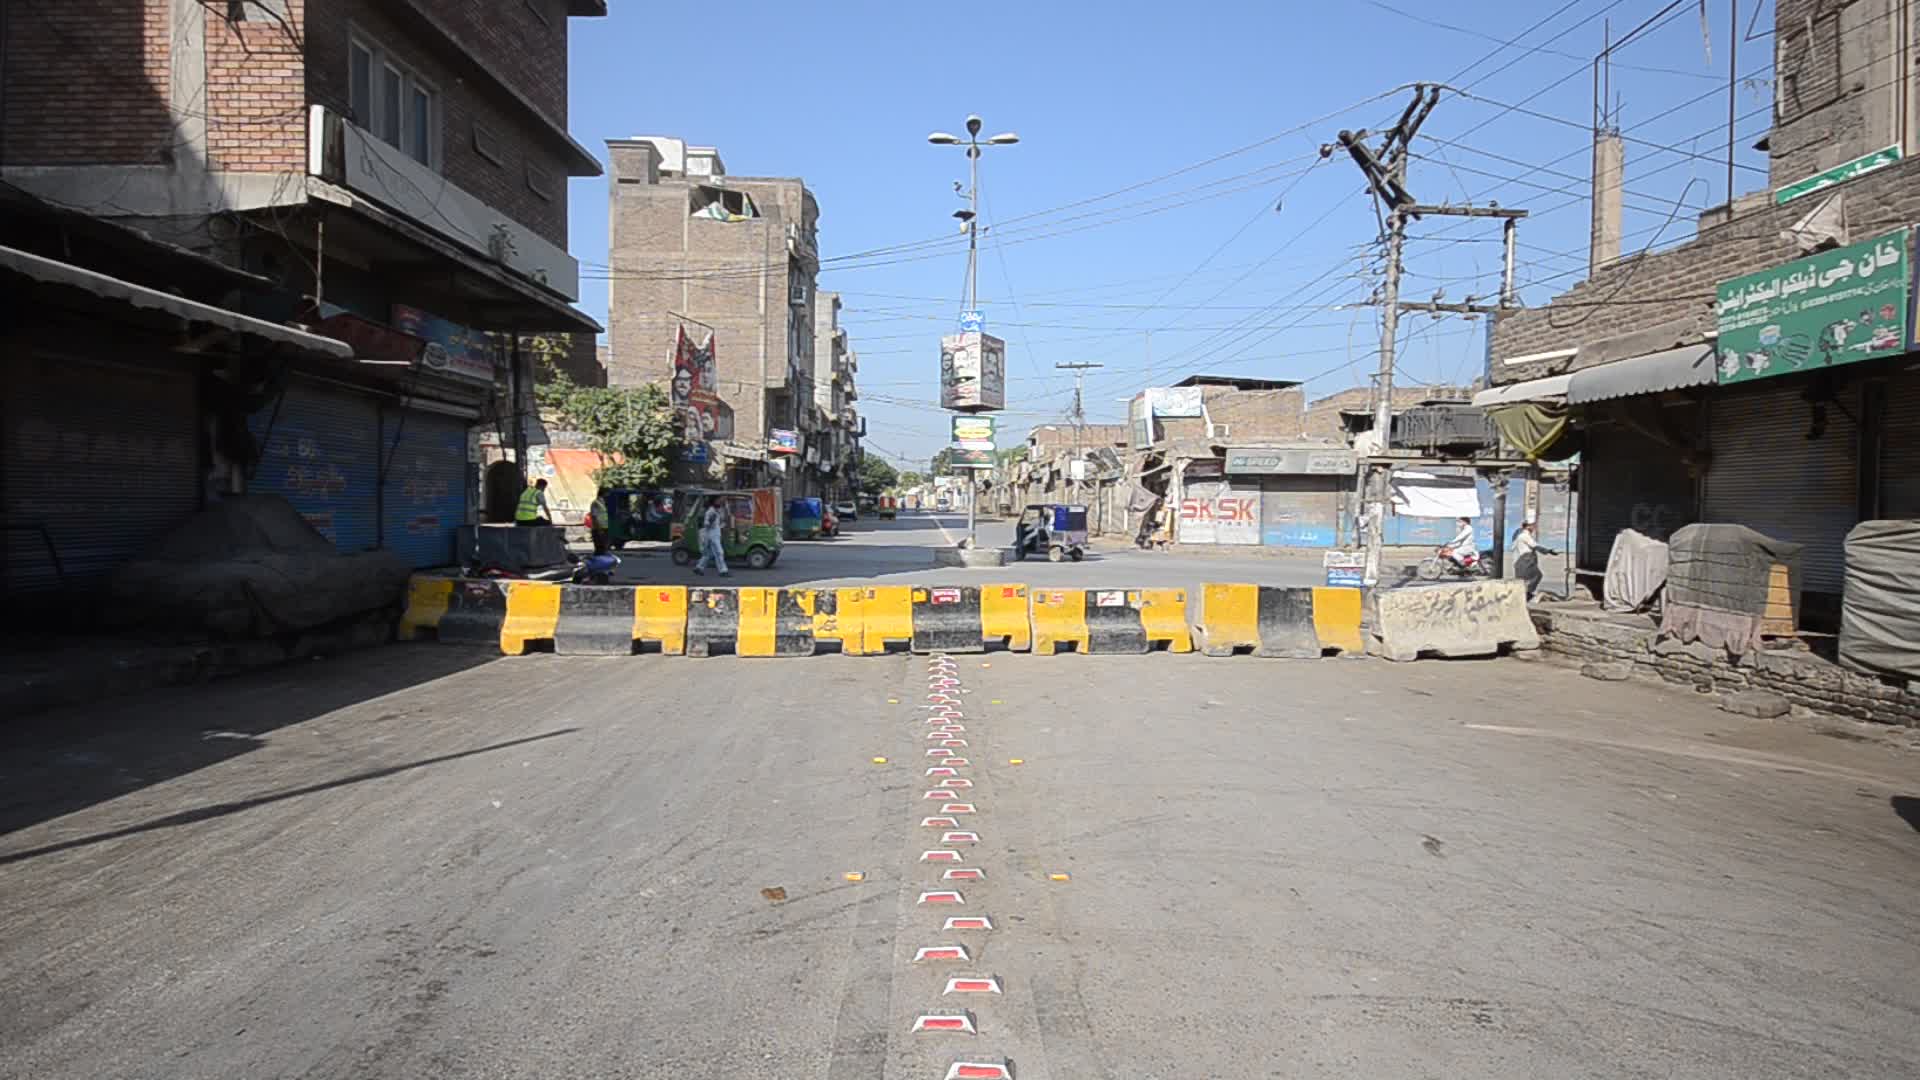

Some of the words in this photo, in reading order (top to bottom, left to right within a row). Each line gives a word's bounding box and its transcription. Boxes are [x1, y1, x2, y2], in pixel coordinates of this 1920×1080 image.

[1858, 240, 1900, 277] خان
[1818, 259, 1854, 288] جی
[1180, 498, 1214, 519] SK
[1217, 498, 1256, 520] SK
